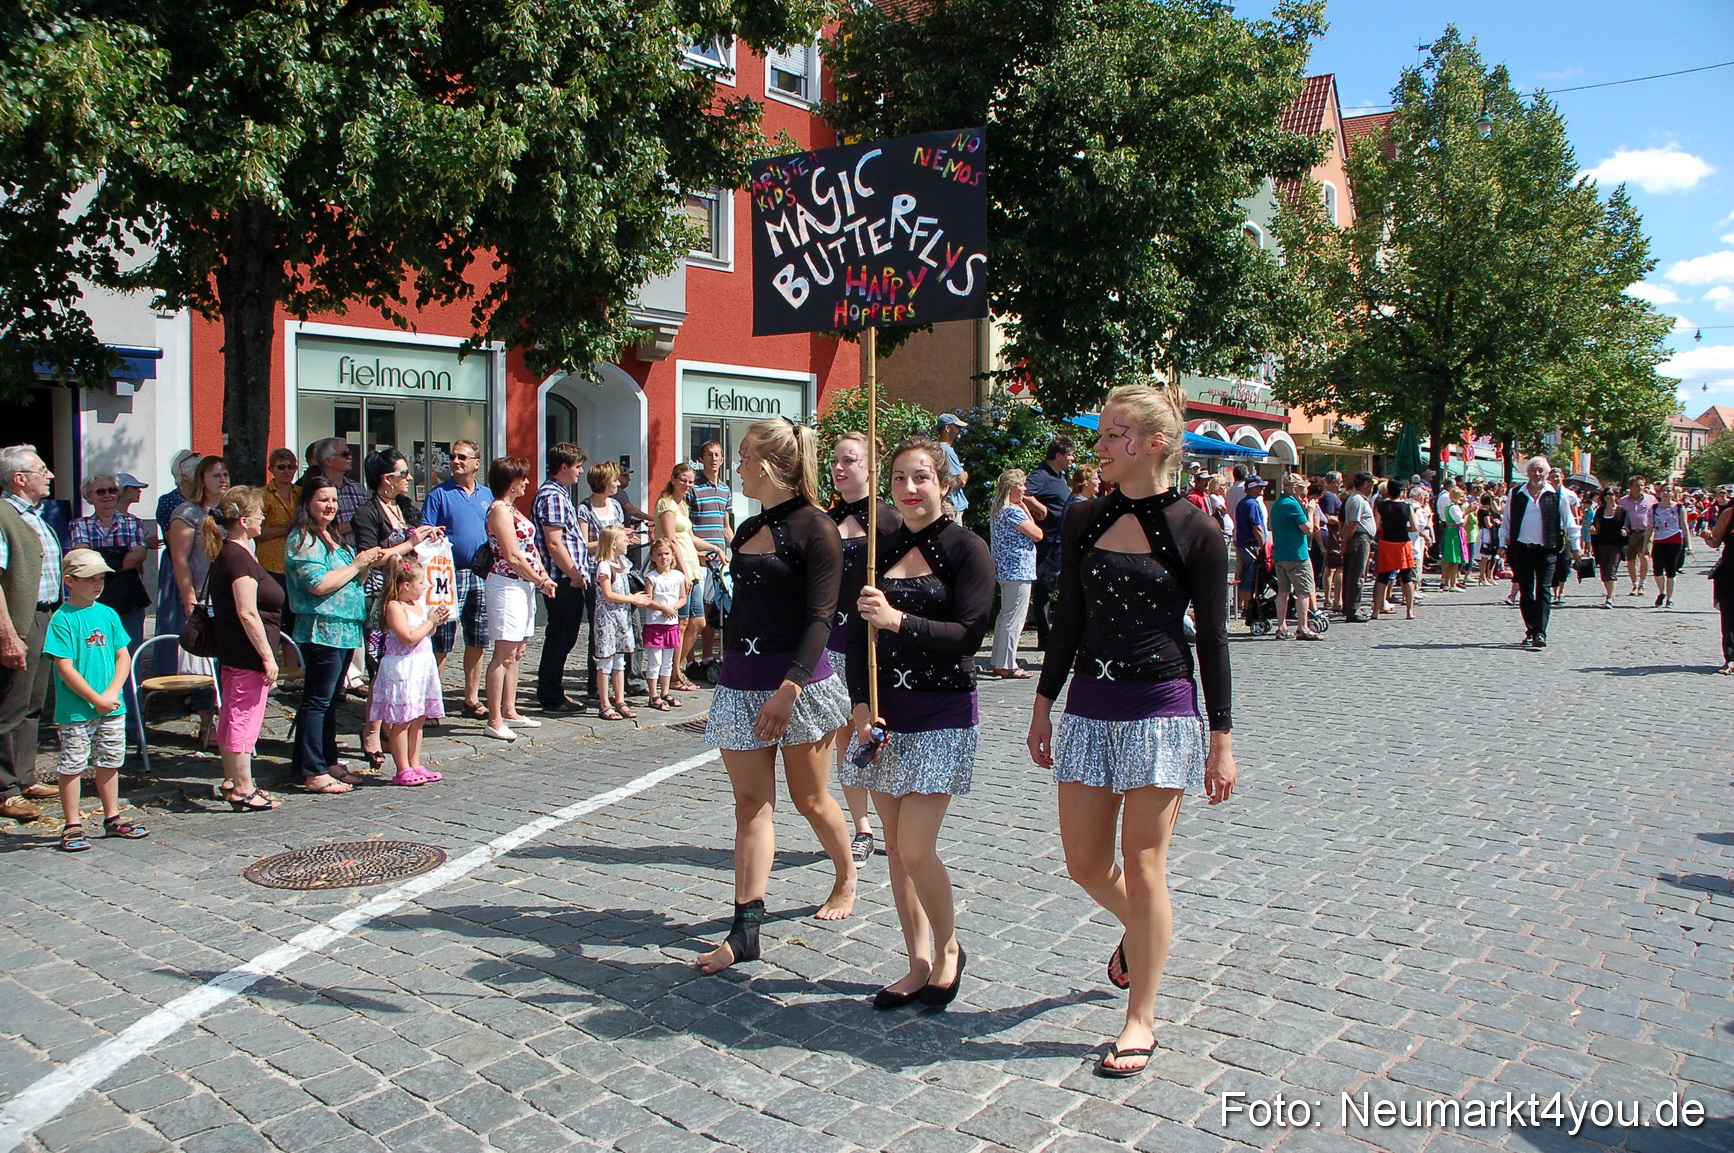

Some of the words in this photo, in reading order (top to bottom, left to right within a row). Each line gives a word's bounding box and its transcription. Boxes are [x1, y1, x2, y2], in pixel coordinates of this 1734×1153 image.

[951, 133, 981, 153] NO
[752, 153, 820, 196] ARTISTEN
[913, 147, 984, 187] NEMOS
[757, 187, 797, 212] KIDS
[765, 149, 883, 257] MAGIC
[772, 194, 988, 309] BUTTERFLYS
[845, 265, 929, 304] HAPPY
[834, 299, 916, 328] HOPPERS
[339, 355, 452, 391] fielmann
[707, 386, 781, 414] fielmann
[435, 577, 449, 595] M
